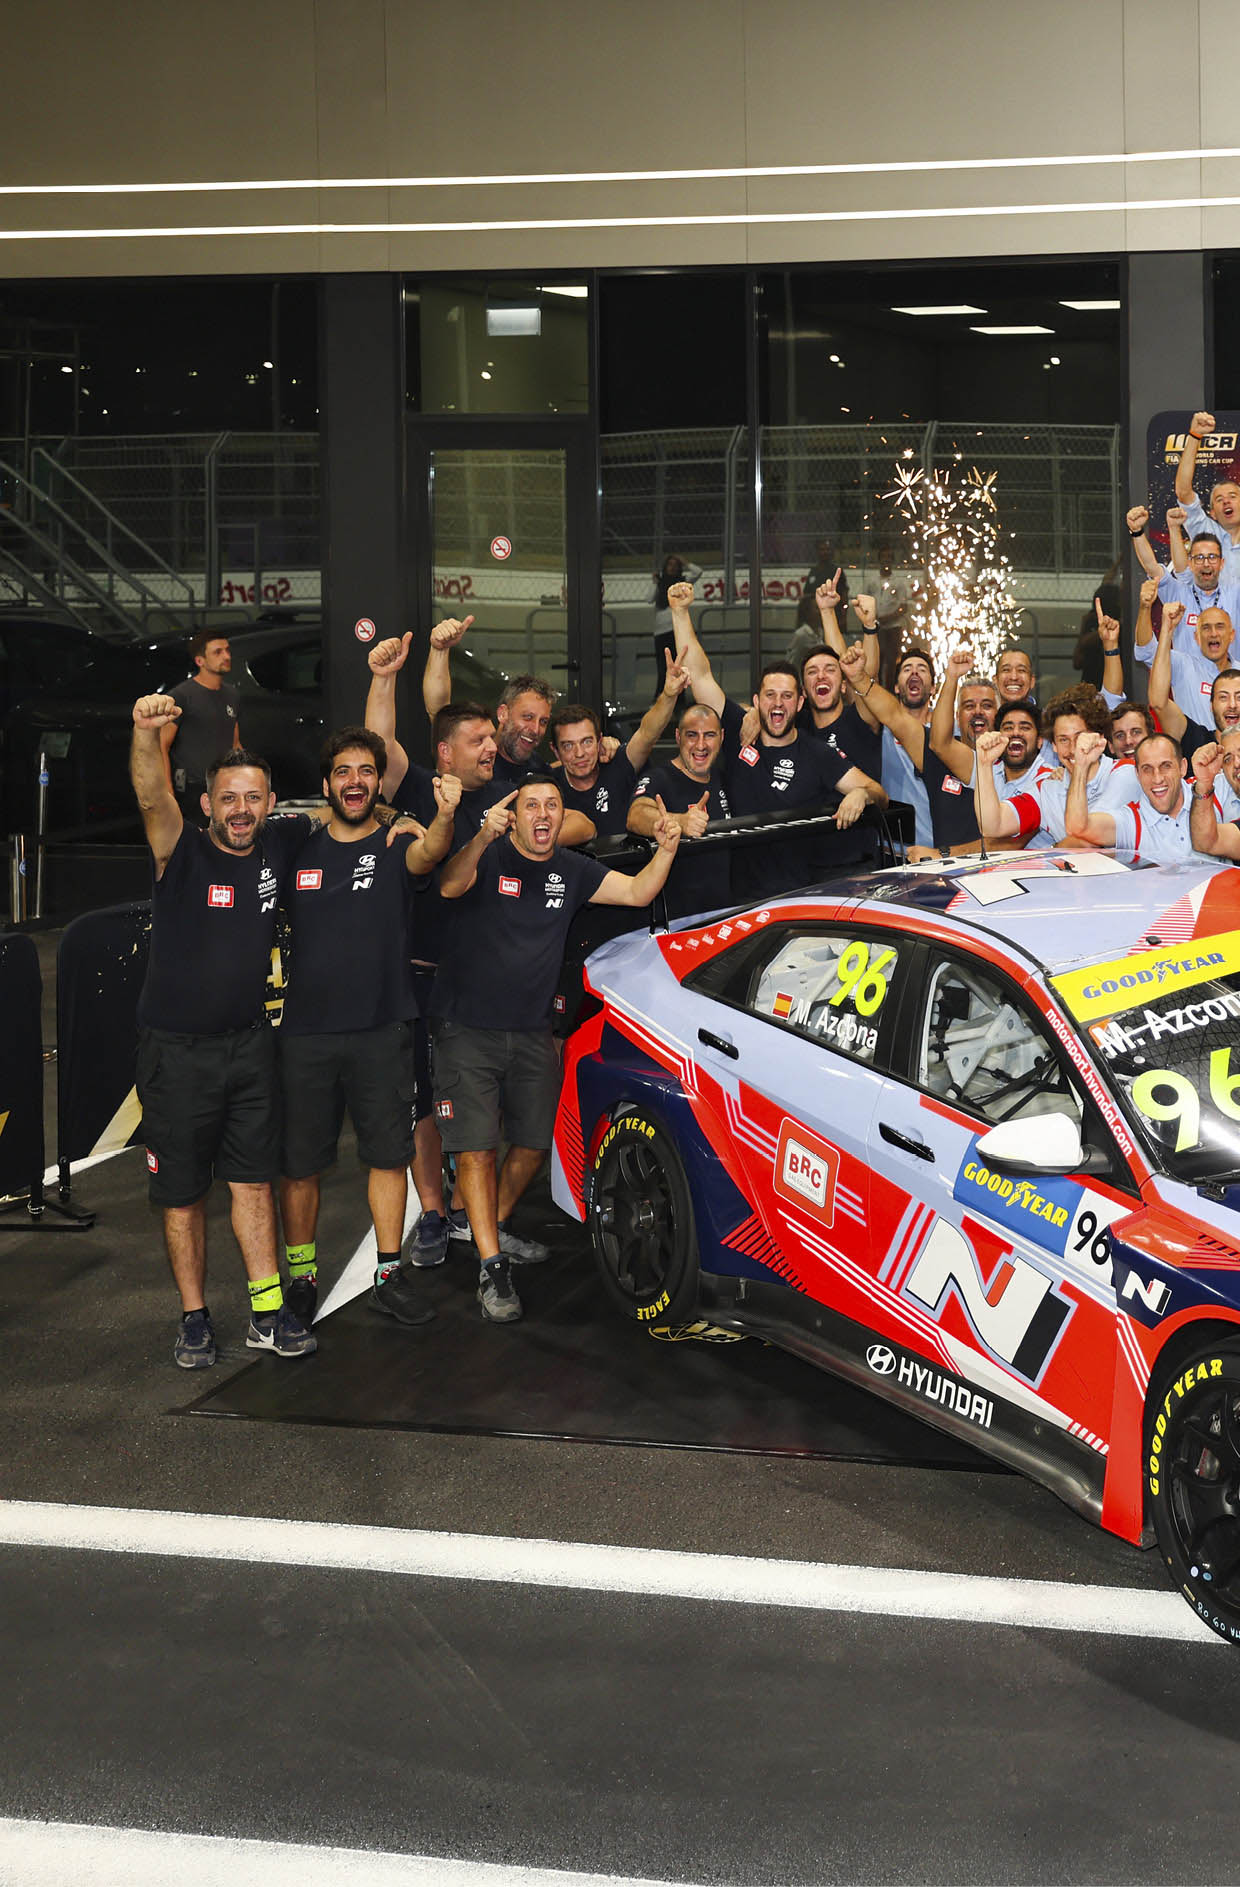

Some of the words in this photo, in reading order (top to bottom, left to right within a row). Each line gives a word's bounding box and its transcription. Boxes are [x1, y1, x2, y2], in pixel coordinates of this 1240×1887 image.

[829, 942, 897, 1017] 96
[795, 1000, 811, 1027] M.
[815, 1006, 878, 1049] Azcona
[1091, 1024, 1146, 1057] M.
[1045, 1008, 1134, 1157] motorsport.hyundai.com
[788, 1152, 821, 1188] BRC
[1073, 1211, 1111, 1265] 96
[637, 1290, 671, 1320] EAGLE
[897, 1357, 995, 1429] HYUNDAI
